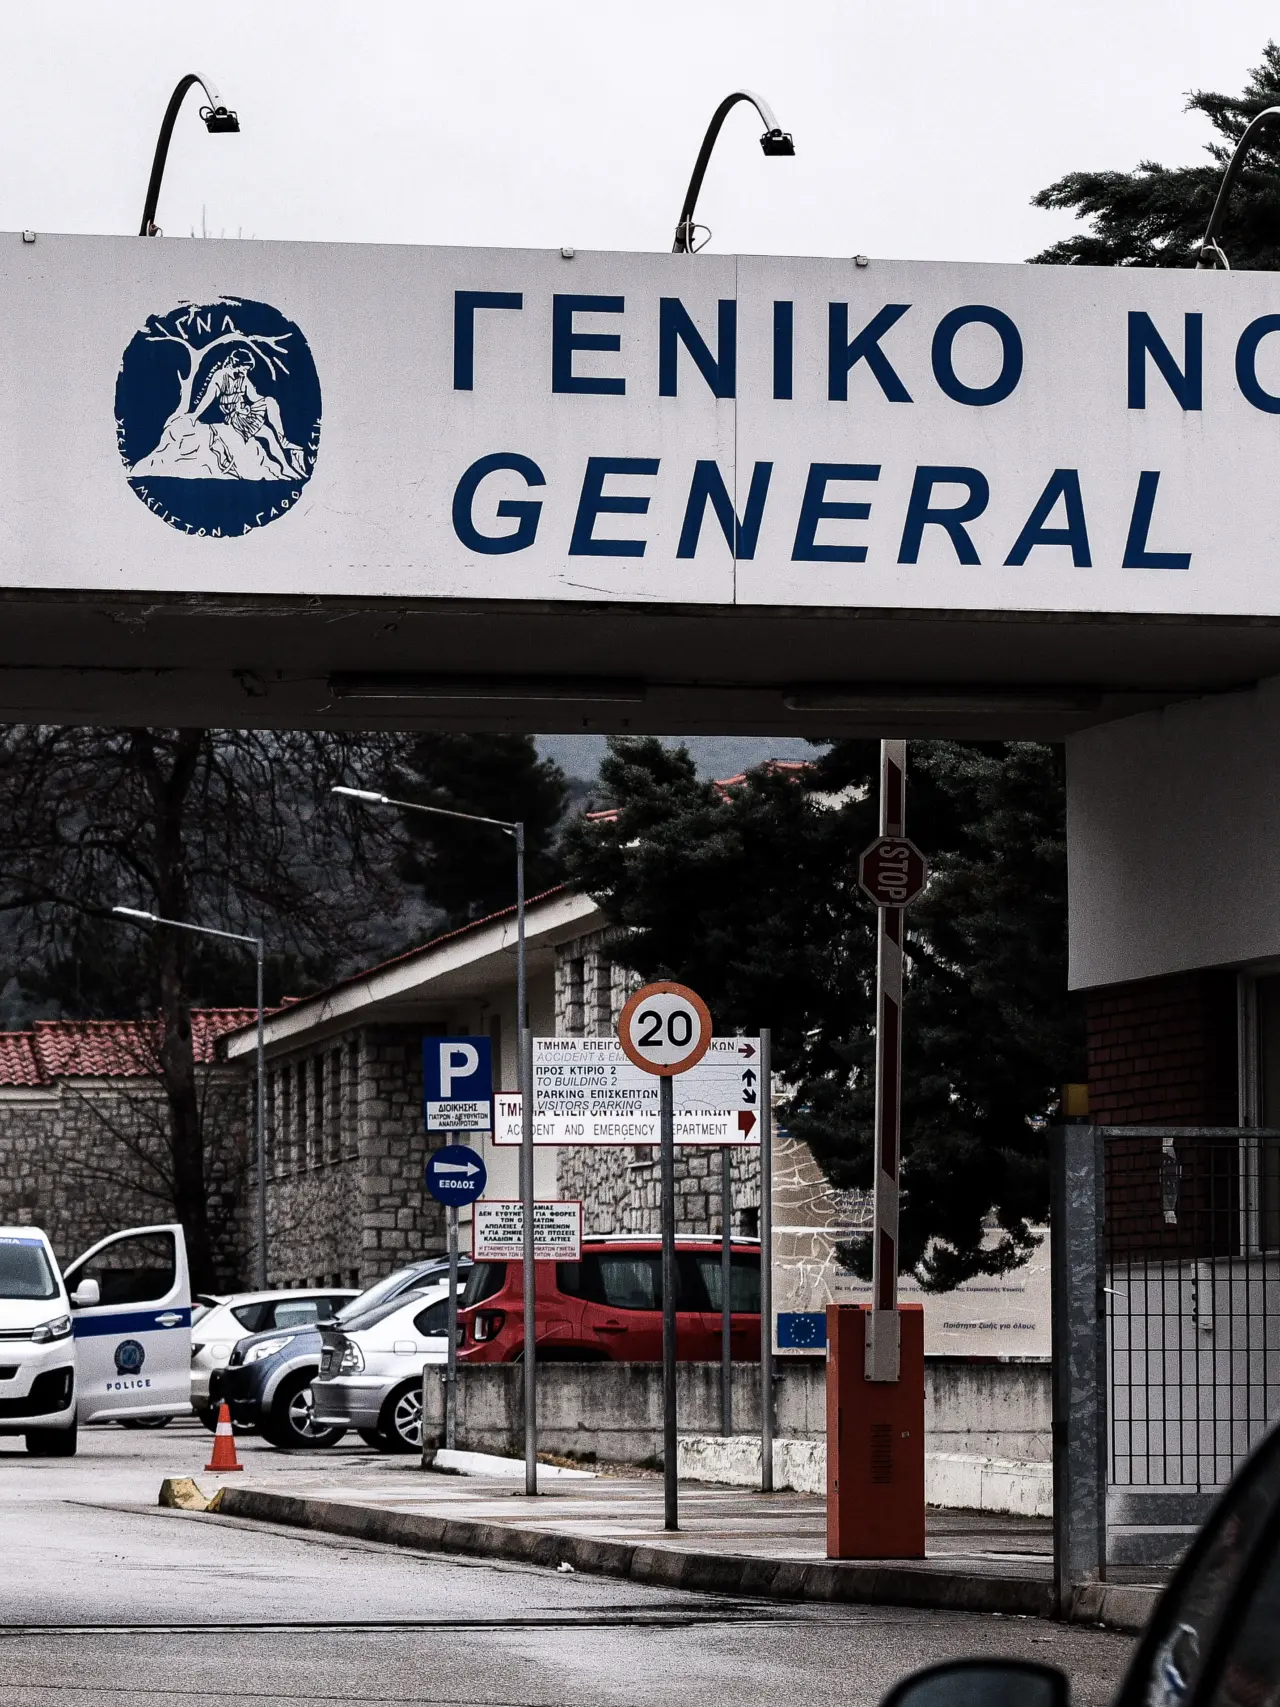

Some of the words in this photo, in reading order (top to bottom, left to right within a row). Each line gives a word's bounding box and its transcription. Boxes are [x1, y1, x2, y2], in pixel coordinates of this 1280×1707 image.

[453, 290, 1024, 406] ΓΕΝΙΚΟ
[451, 452, 1193, 570] GENERAL
[878, 846, 910, 900] STOP
[638, 1010, 693, 1047] 20
[536, 1041, 577, 1051] ΤΜΗΜΑ
[583, 1041, 622, 1051] ΕΠΕΙΓΟ
[537, 1052, 596, 1062] ACCIDENT
[598, 1052, 605, 1062] &
[439, 1042, 480, 1098] P
[536, 1066, 564, 1076] ΠΡΟΣ
[570, 1066, 605, 1076] ΚΤΙΡΙΟ
[610, 1066, 617, 1075] 2
[537, 1077, 552, 1087] TO
[554, 1077, 608, 1087] BUILDING
[611, 1077, 618, 1086] 2
[536, 1089, 585, 1099] PARKING
[590, 1089, 658, 1099] ΕΠΙΣΚΕΠΤΩΝ
[438, 1103, 478, 1113] ΔΙΟΙΚΗΣΗΣ
[538, 1100, 590, 1110] VISITORS
[592, 1100, 643, 1110] PARKING
[564, 1124, 585, 1136] AND
[593, 1124, 655, 1136] EMERGENCY
[672, 1124, 728, 1136] EPARTMENT
[438, 1179, 475, 1189] ΕΞΟΔΟΣ
[106, 1379, 151, 1391] POLICE
